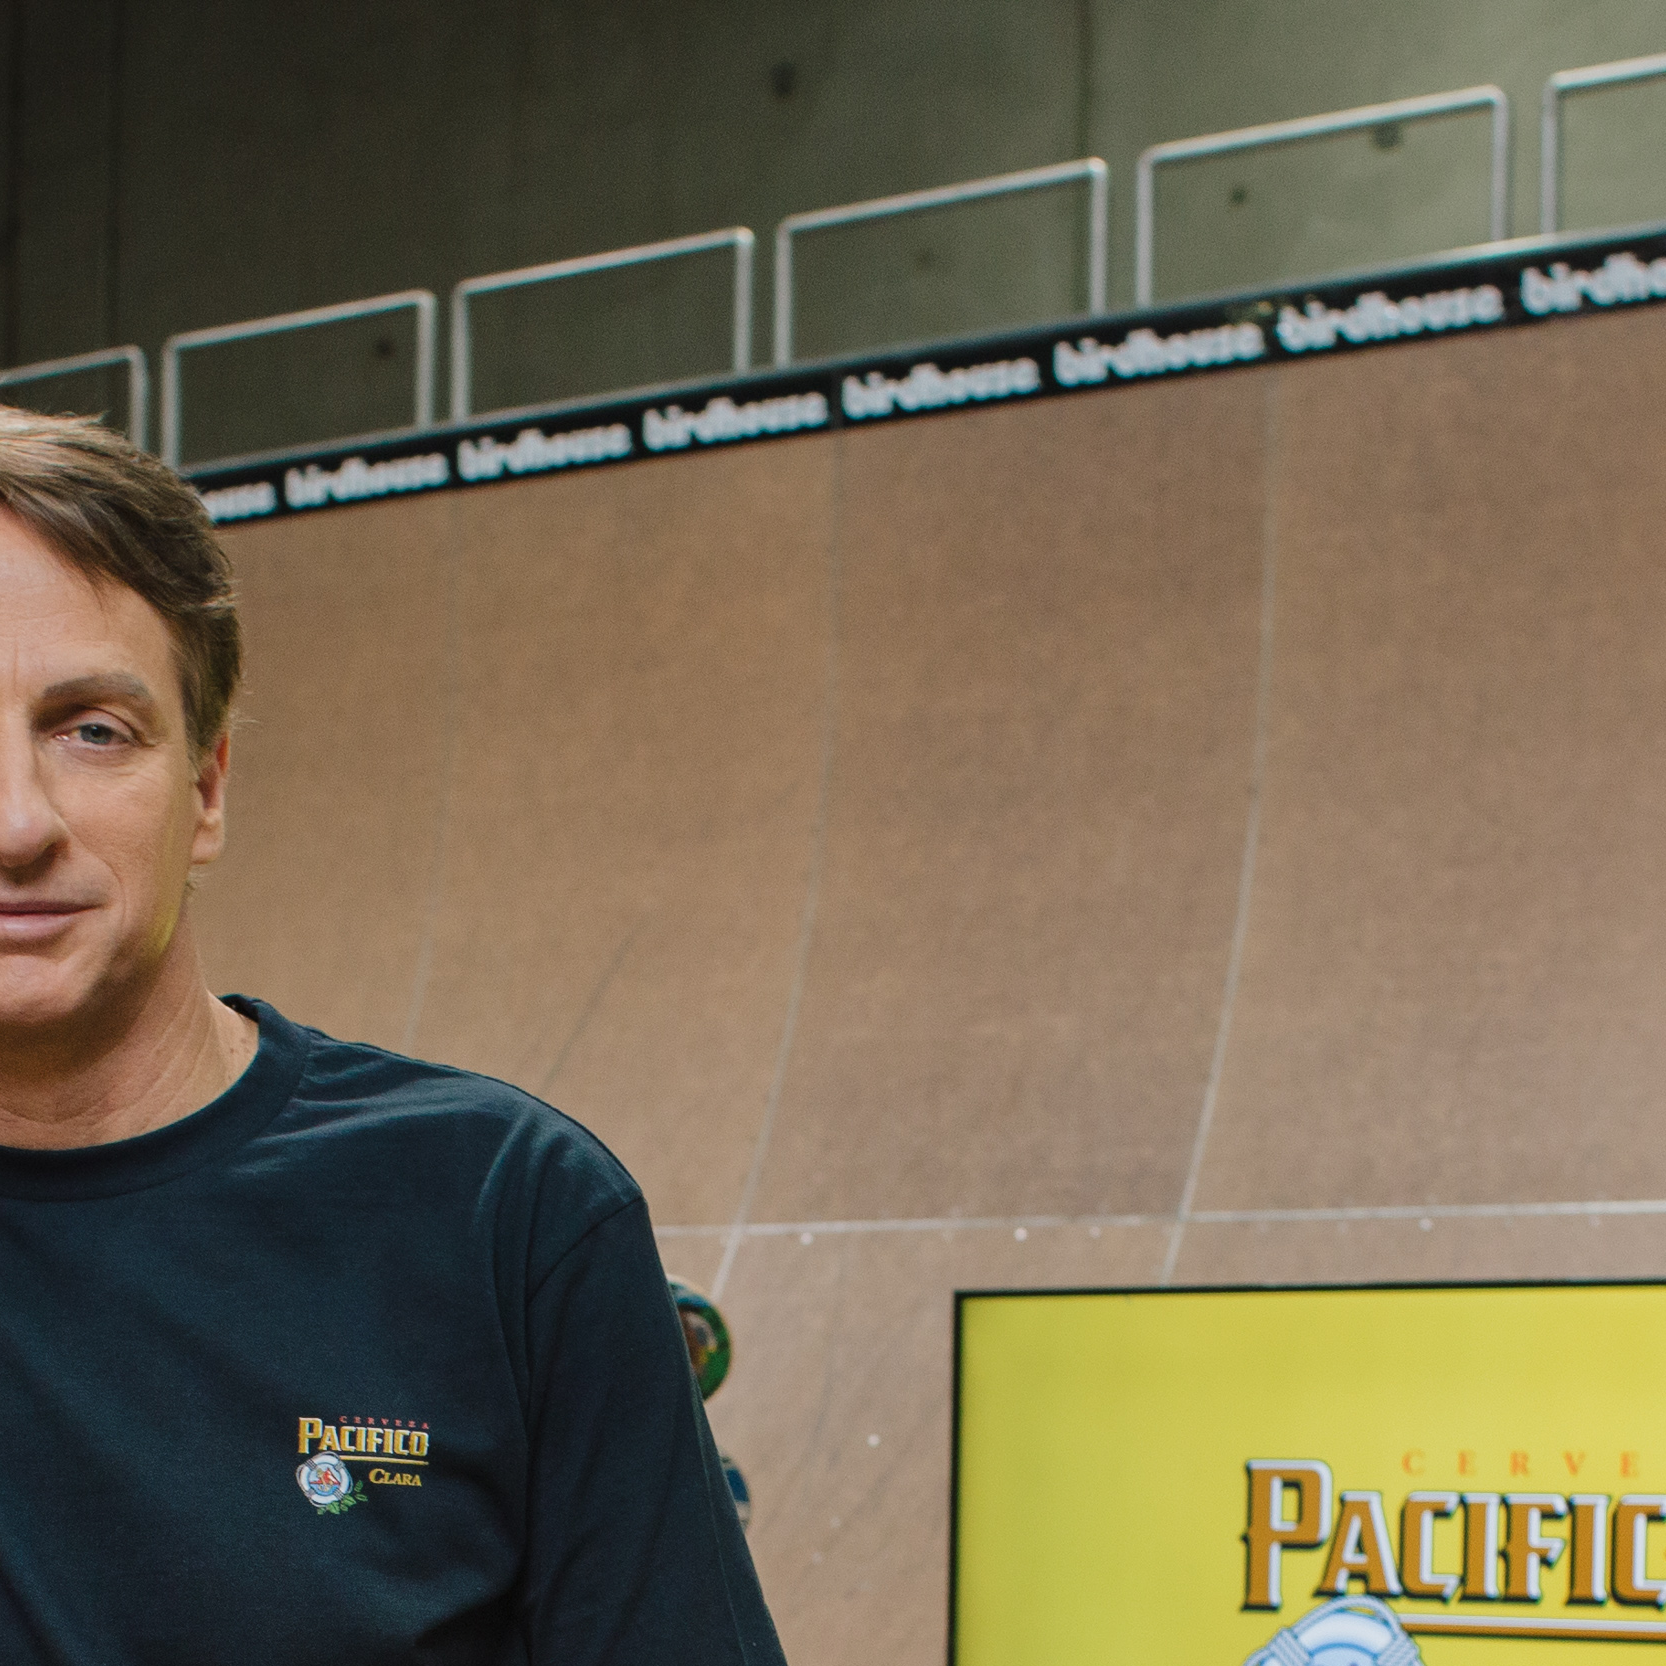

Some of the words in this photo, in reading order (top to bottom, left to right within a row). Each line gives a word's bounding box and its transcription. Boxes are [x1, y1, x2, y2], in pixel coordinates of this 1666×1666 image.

[339, 1416, 429, 1430] CERVEZA
[298, 1417, 429, 1457] PACIFICO
[369, 1468, 422, 1487] CLARA
